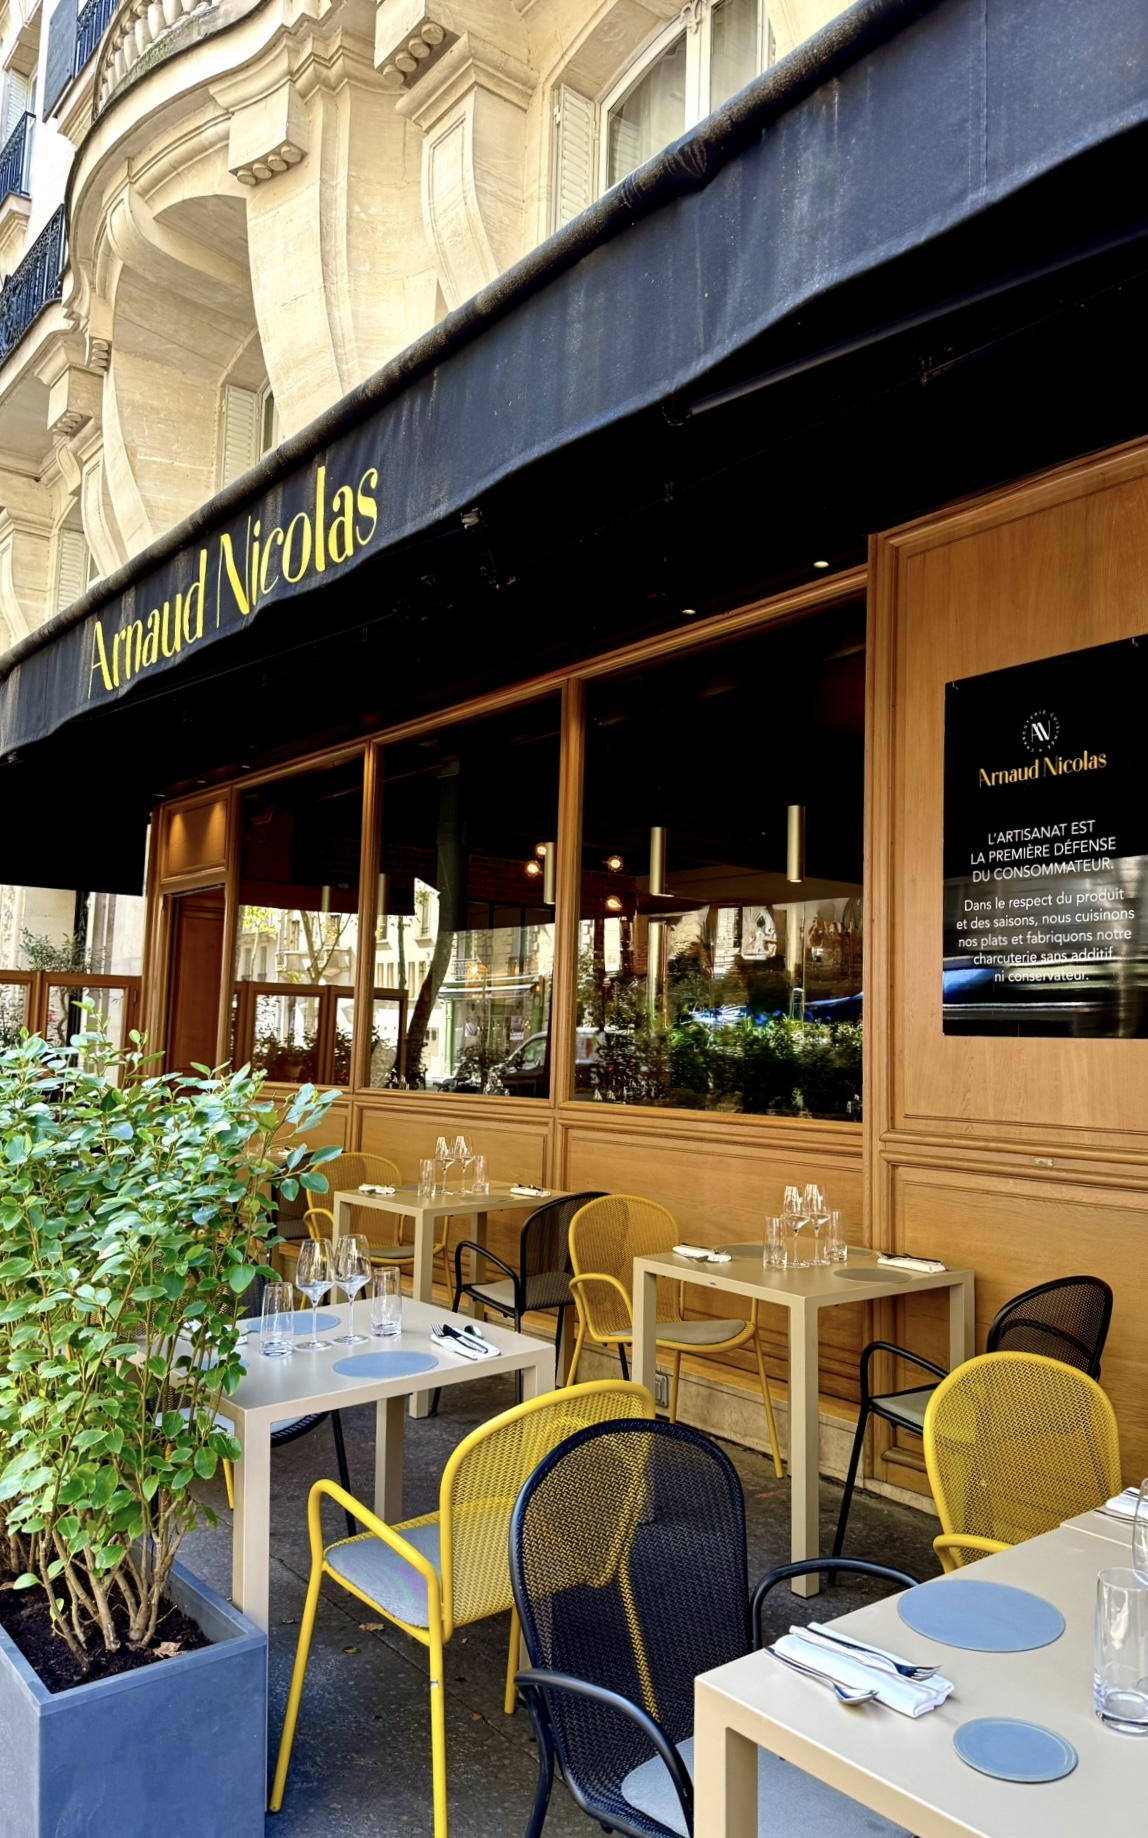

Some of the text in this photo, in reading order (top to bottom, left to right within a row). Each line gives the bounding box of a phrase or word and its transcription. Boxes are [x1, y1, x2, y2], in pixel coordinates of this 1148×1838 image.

[88, 466, 378, 699] Arnaud Nicolas
[979, 750, 1107, 788] Arnaud Nicolas
[988, 819, 1096, 845] L'ARTISANAT EST
[971, 836, 1117, 865] LA PREMIÈRE DÉFENSE
[972, 857, 1114, 883] DU CONSOMMATEUR.
[964, 887, 1125, 912] Dans le respect du produit
[956, 908, 1135, 930] et des saisons, nous cuisinons
[958, 929, 1132, 949] nos plats et fabriquons notre
[973, 945, 1114, 966] charcuterie sans additif
[994, 969, 1090, 983] ni conservateur.
